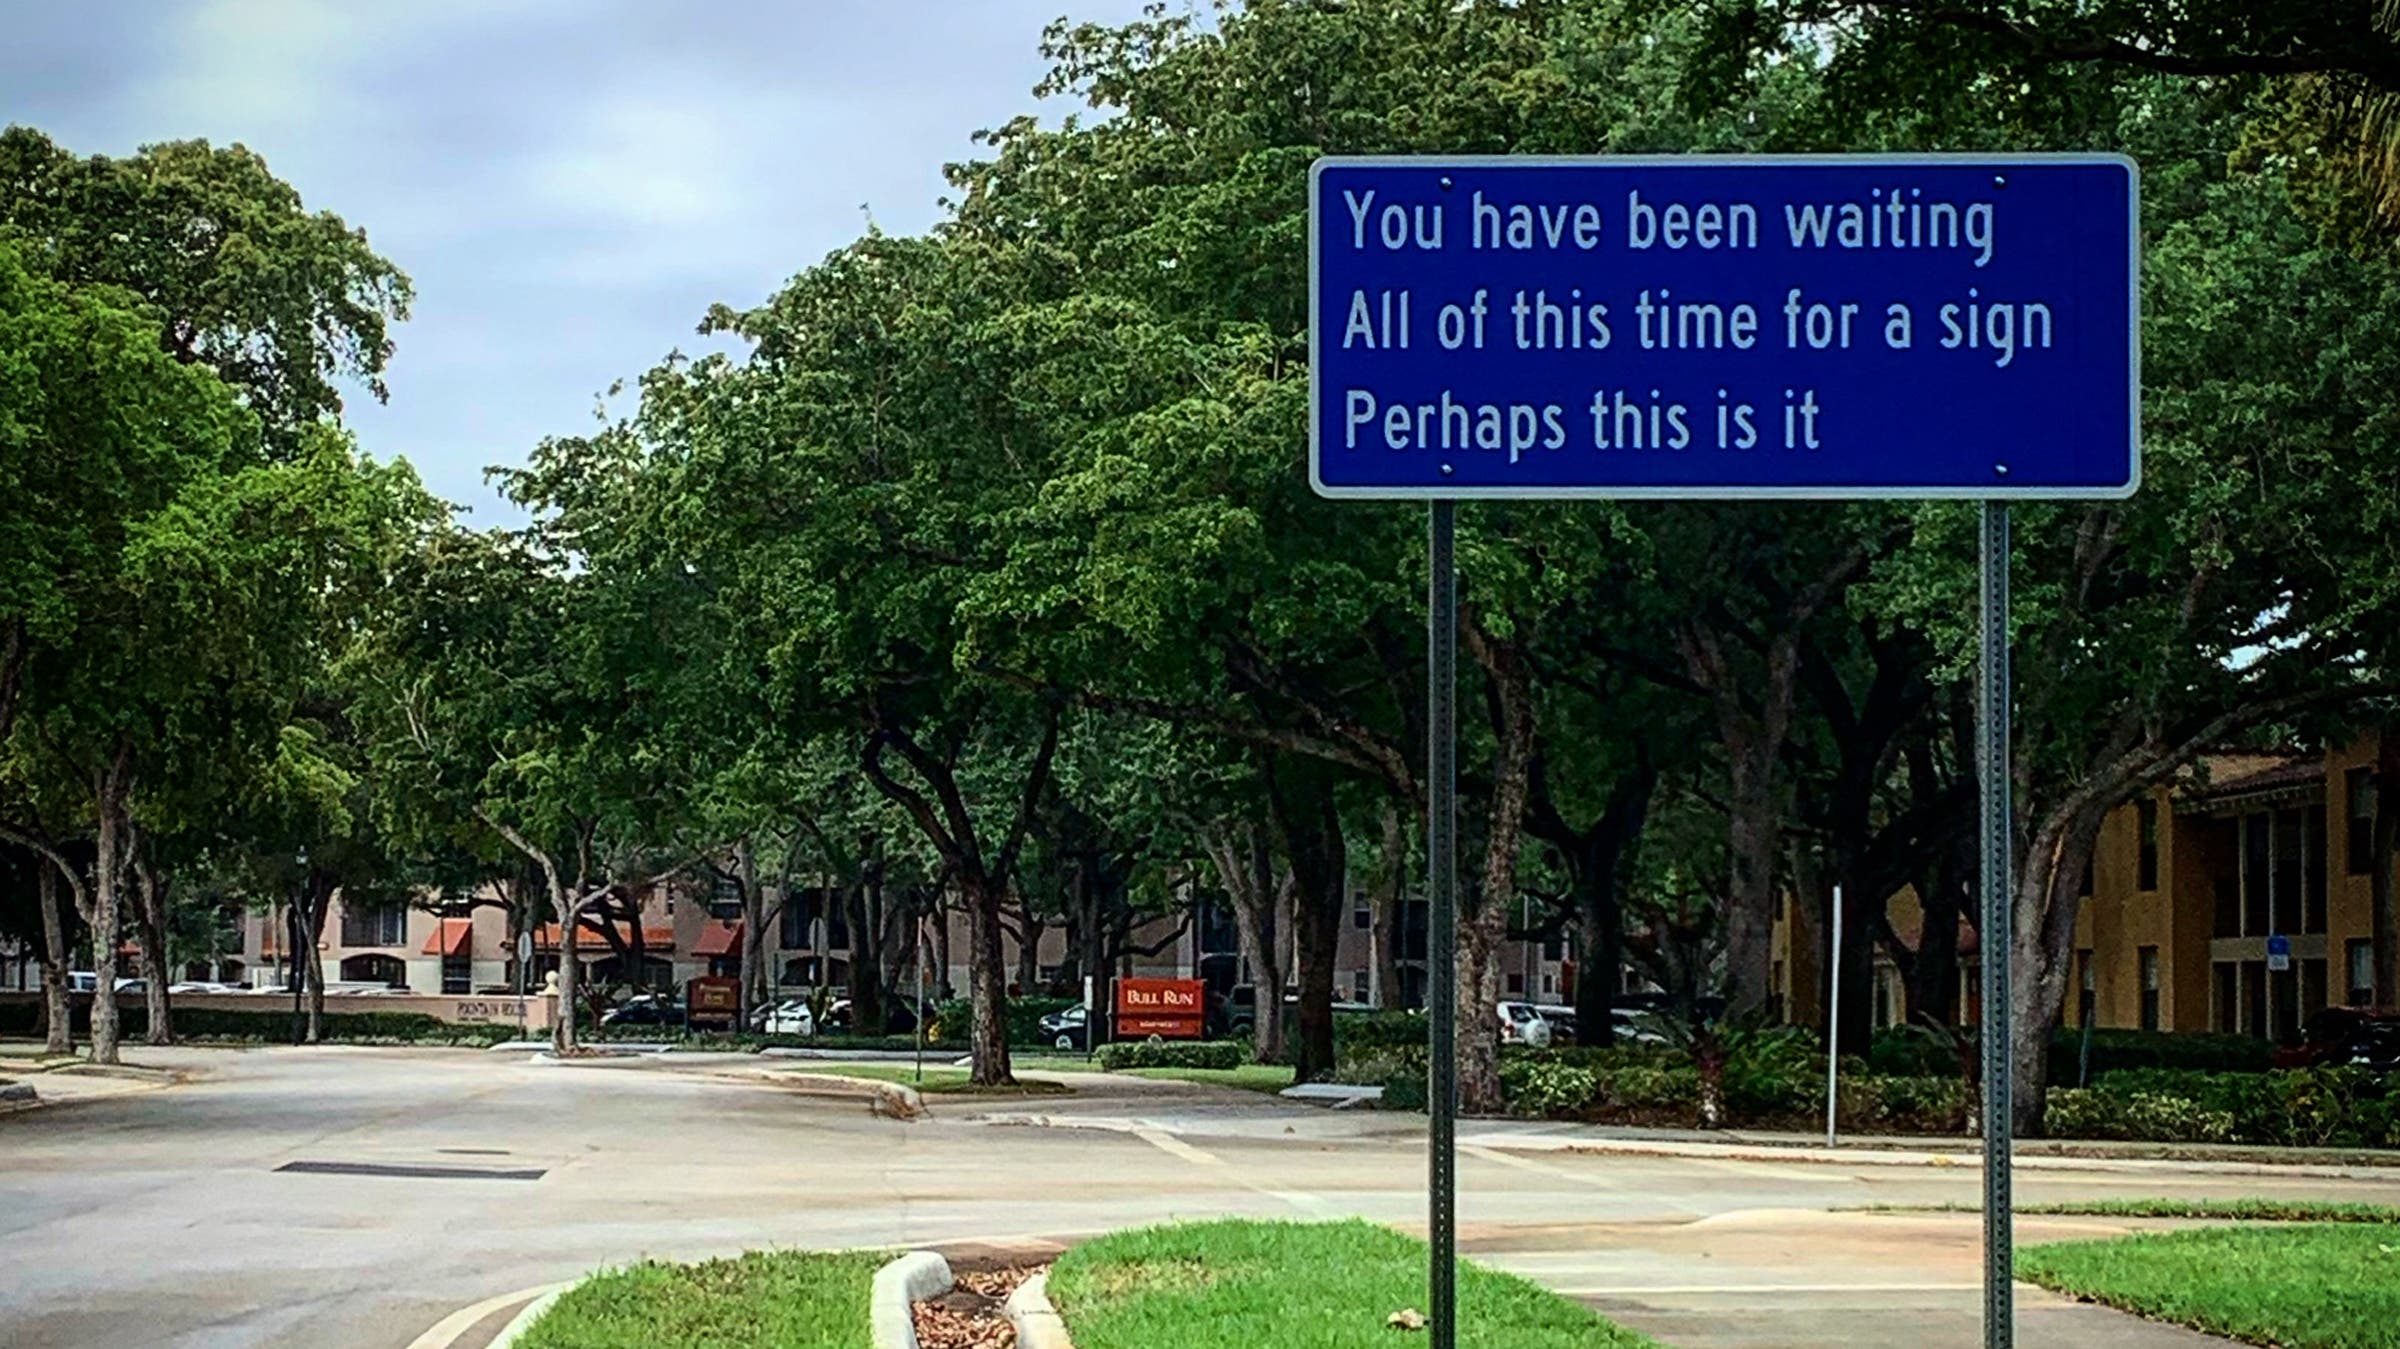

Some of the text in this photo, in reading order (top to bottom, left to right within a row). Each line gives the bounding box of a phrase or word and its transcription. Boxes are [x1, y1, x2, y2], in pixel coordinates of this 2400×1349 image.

[1343, 188, 1994, 268] You have been waiting
[1342, 287, 2052, 368] All of this time for a sign
[1345, 388, 1820, 464] Perhaps this is it
[1127, 989, 1194, 1005] BULL RUN
